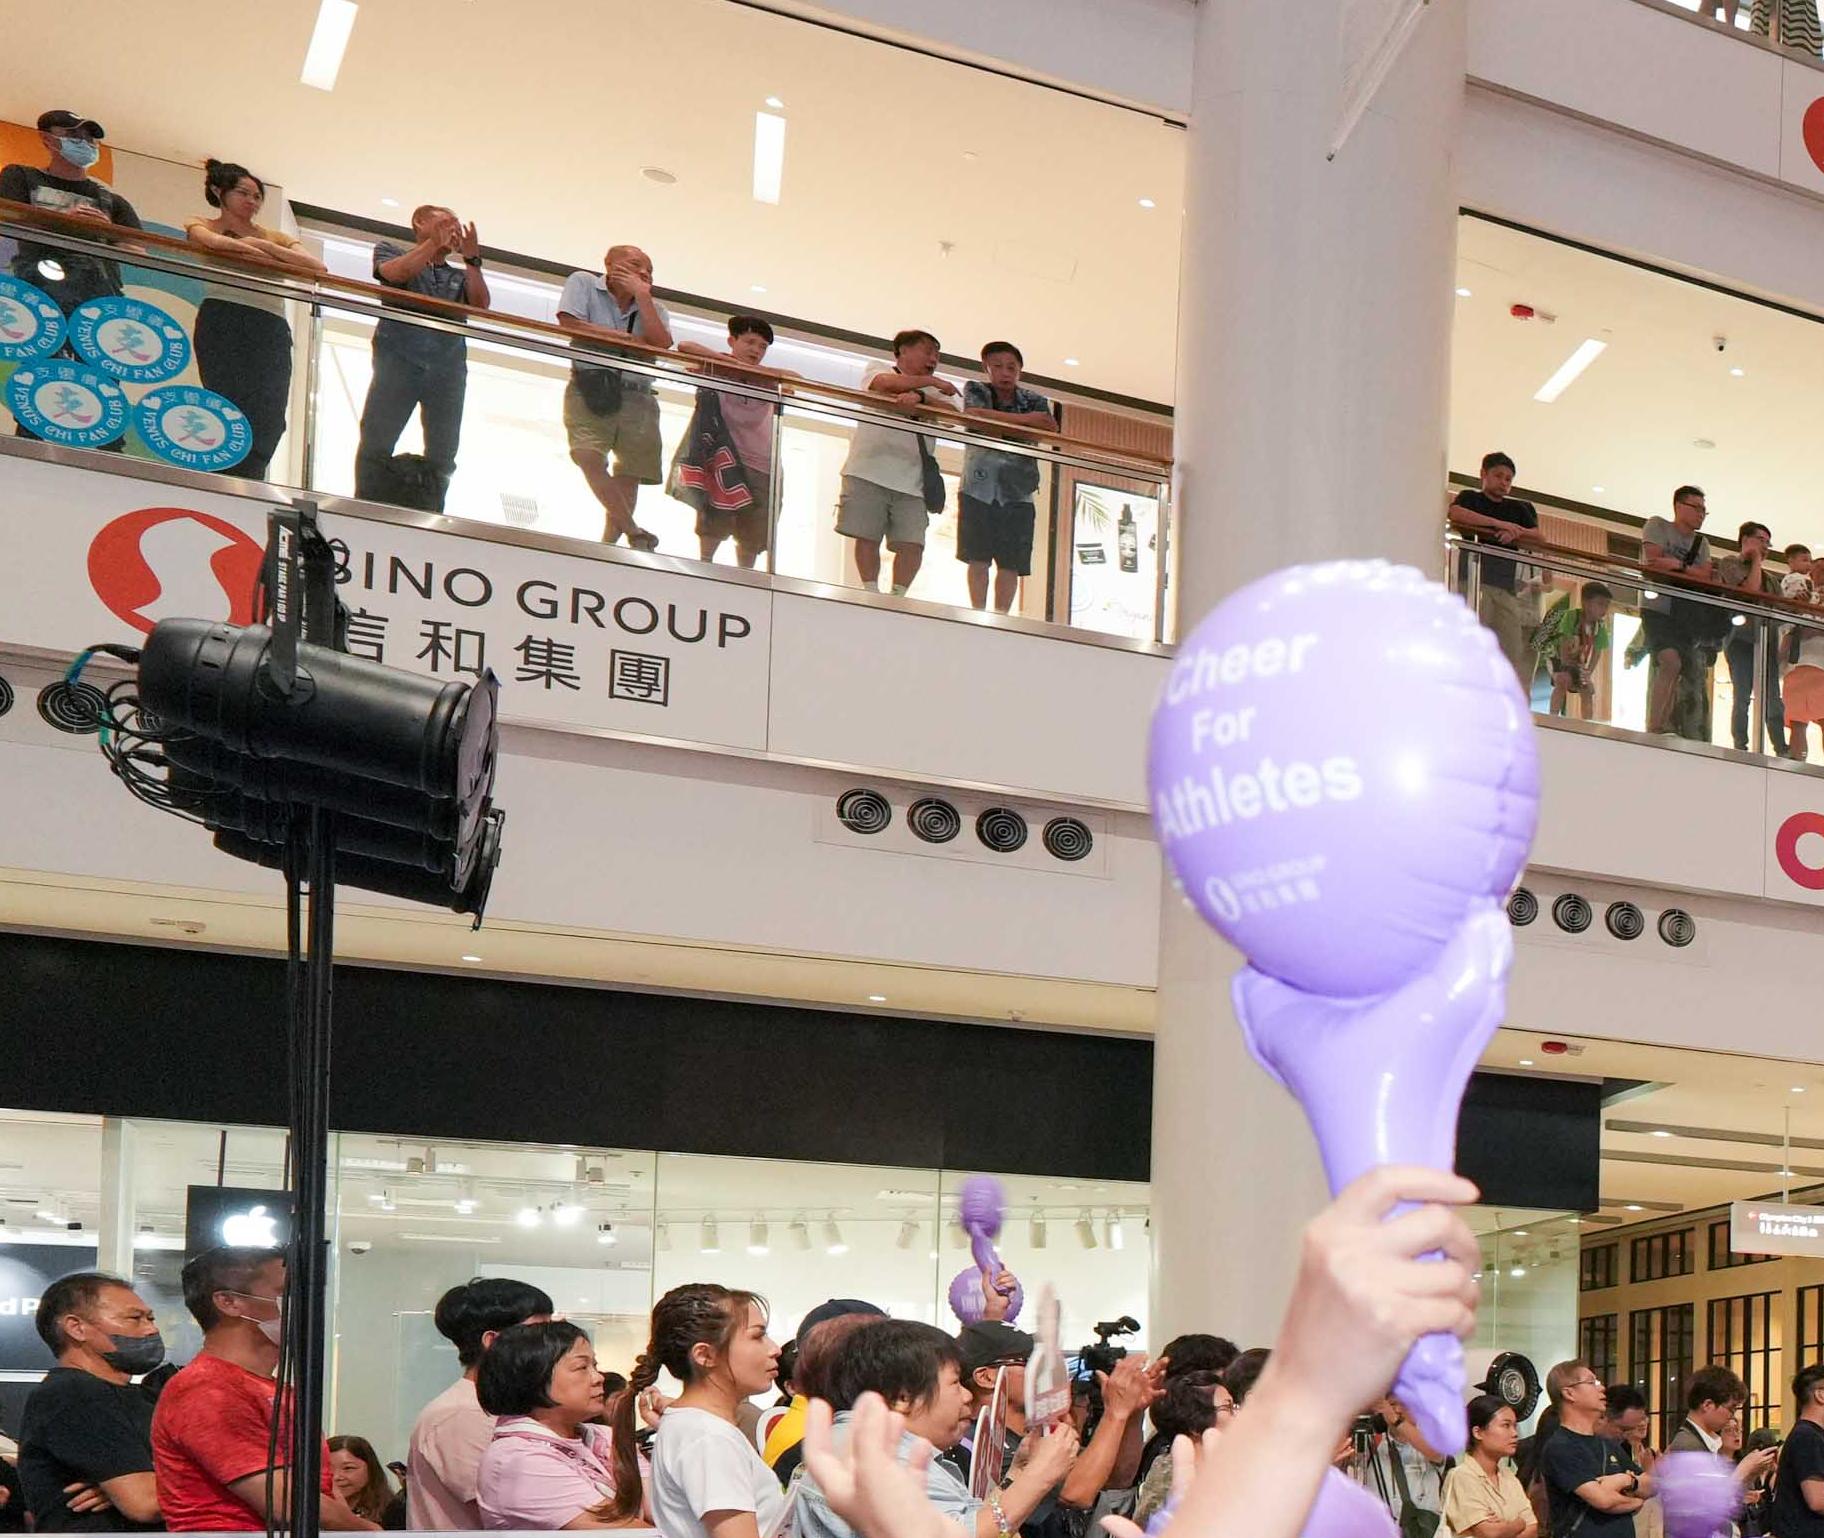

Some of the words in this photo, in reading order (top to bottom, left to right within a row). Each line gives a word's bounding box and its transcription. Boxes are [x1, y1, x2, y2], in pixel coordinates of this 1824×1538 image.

[40, 320, 59, 350] CLUB
[77, 319, 99, 359] VENUS
[134, 366, 165, 379] FAN
[164, 341, 184, 371] CLUB
[15, 386, 41, 427] VENUS
[78, 426, 110, 443] FAN
[106, 399, 125, 430] CLUB
[142, 409, 169, 450] VENUS
[202, 450, 233, 466] FAN
[229, 419, 245, 452] CLUB
[516, 579, 752, 649] GROUP
[346, 606, 671, 708] 信和集團
[1167, 632, 1321, 706] Cheer
[1192, 705, 1257, 753] For
[1156, 756, 1364, 839] Athletes
